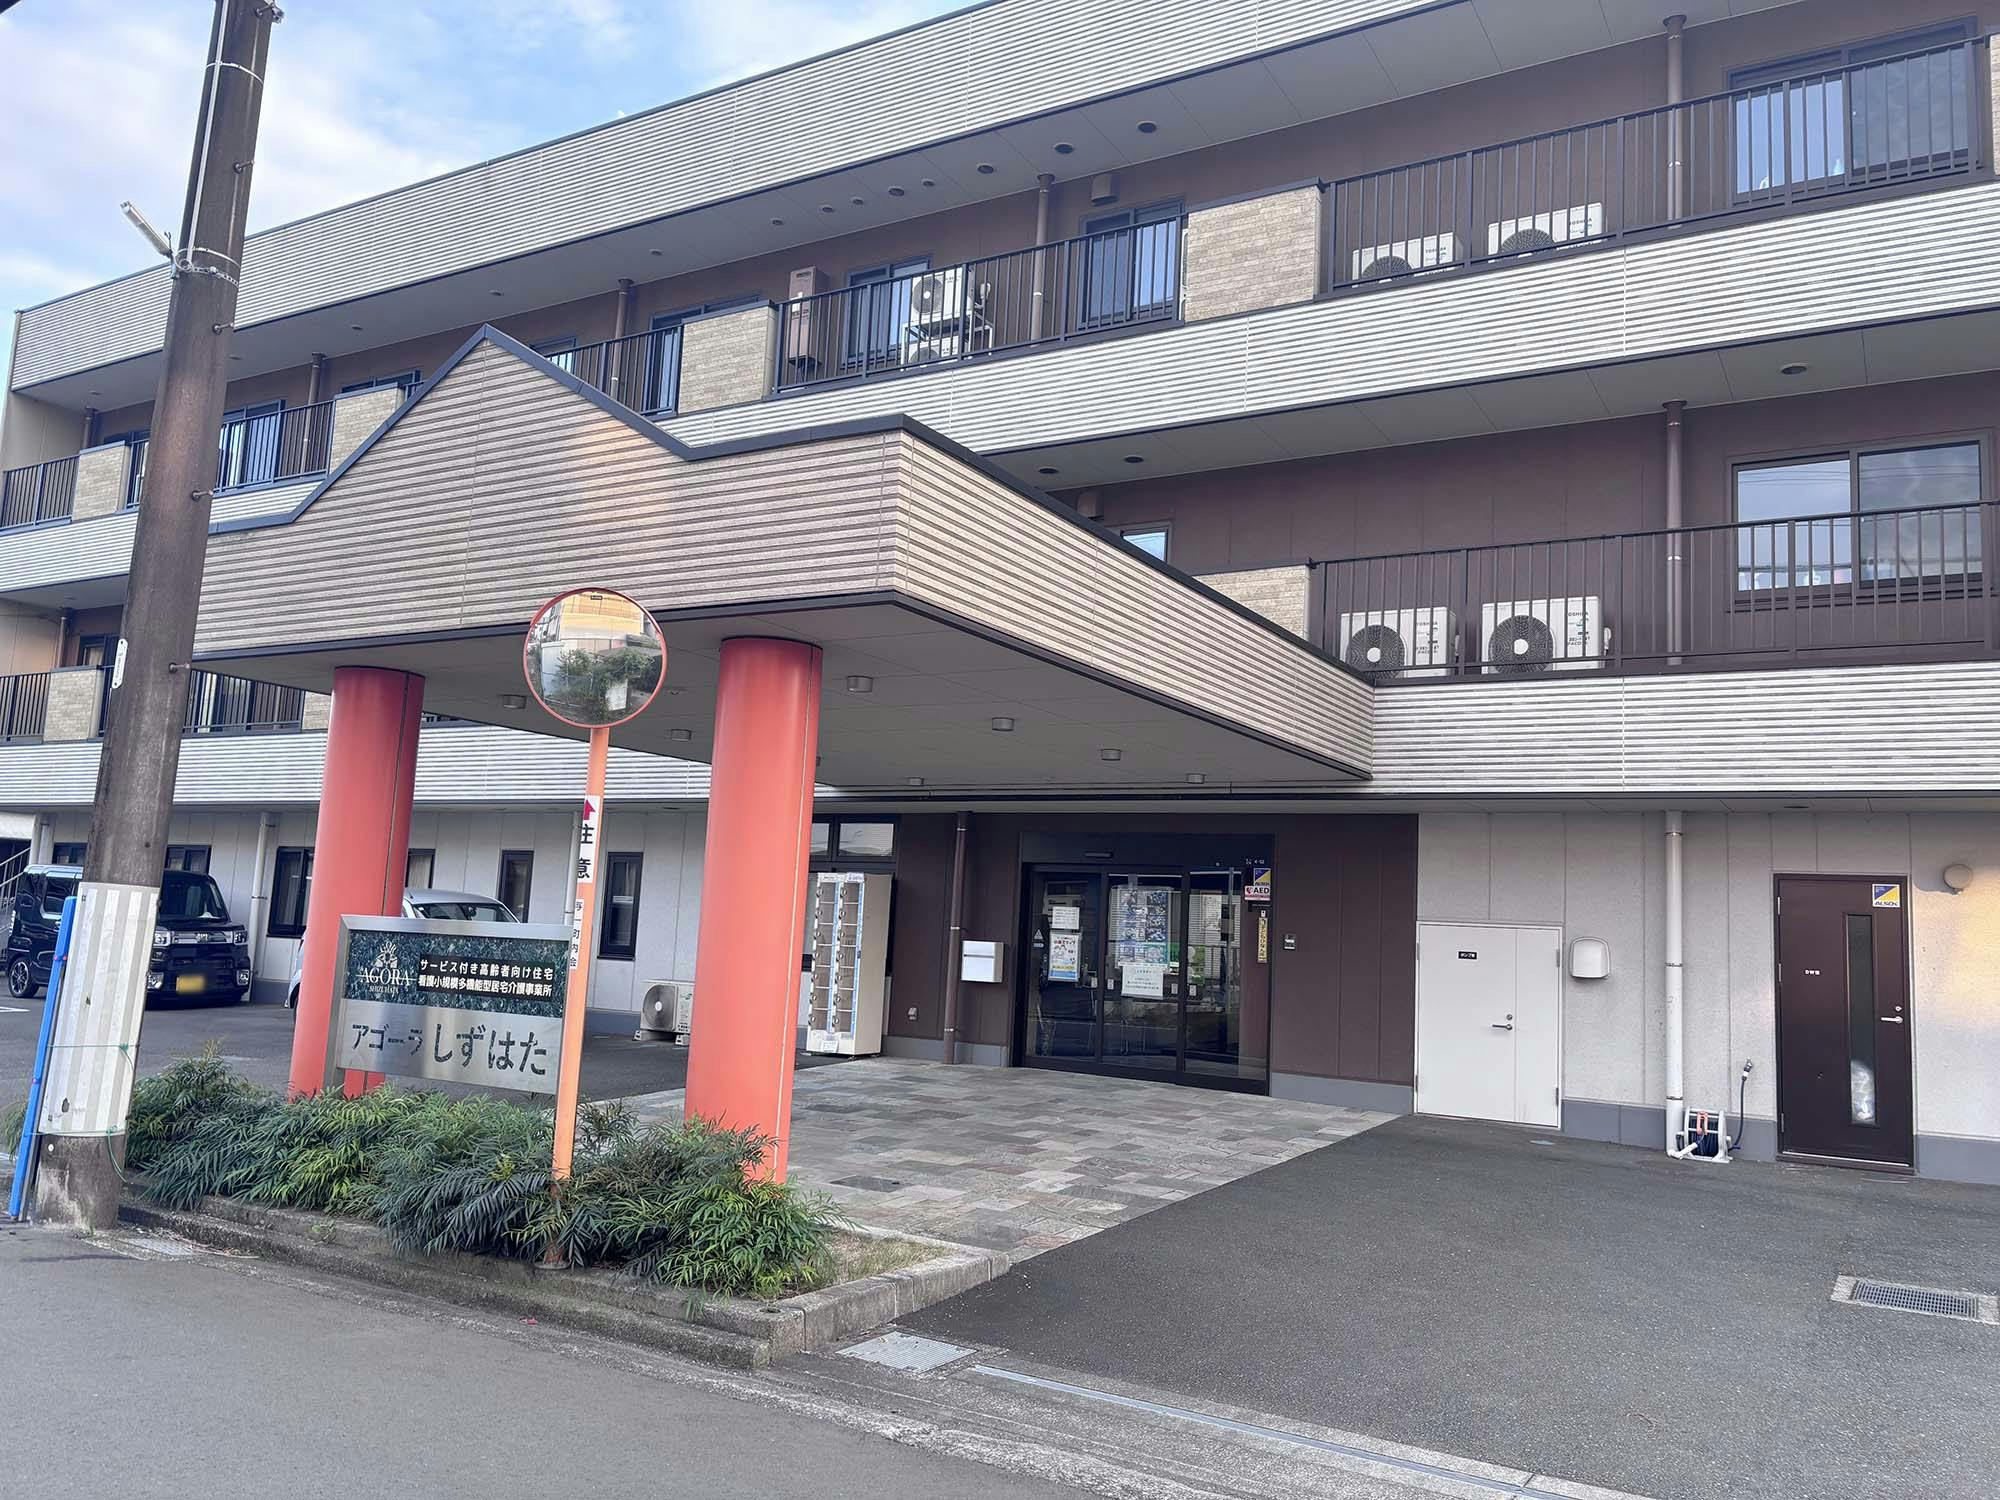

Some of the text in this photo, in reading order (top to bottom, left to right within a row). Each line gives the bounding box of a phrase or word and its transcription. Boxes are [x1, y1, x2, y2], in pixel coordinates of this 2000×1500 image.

[360, 967, 410, 986] AGORA
[420, 959, 553, 980] サービス付き高齢者向け住宅
[352, 1023, 547, 1076] アゴーラ しずはた
